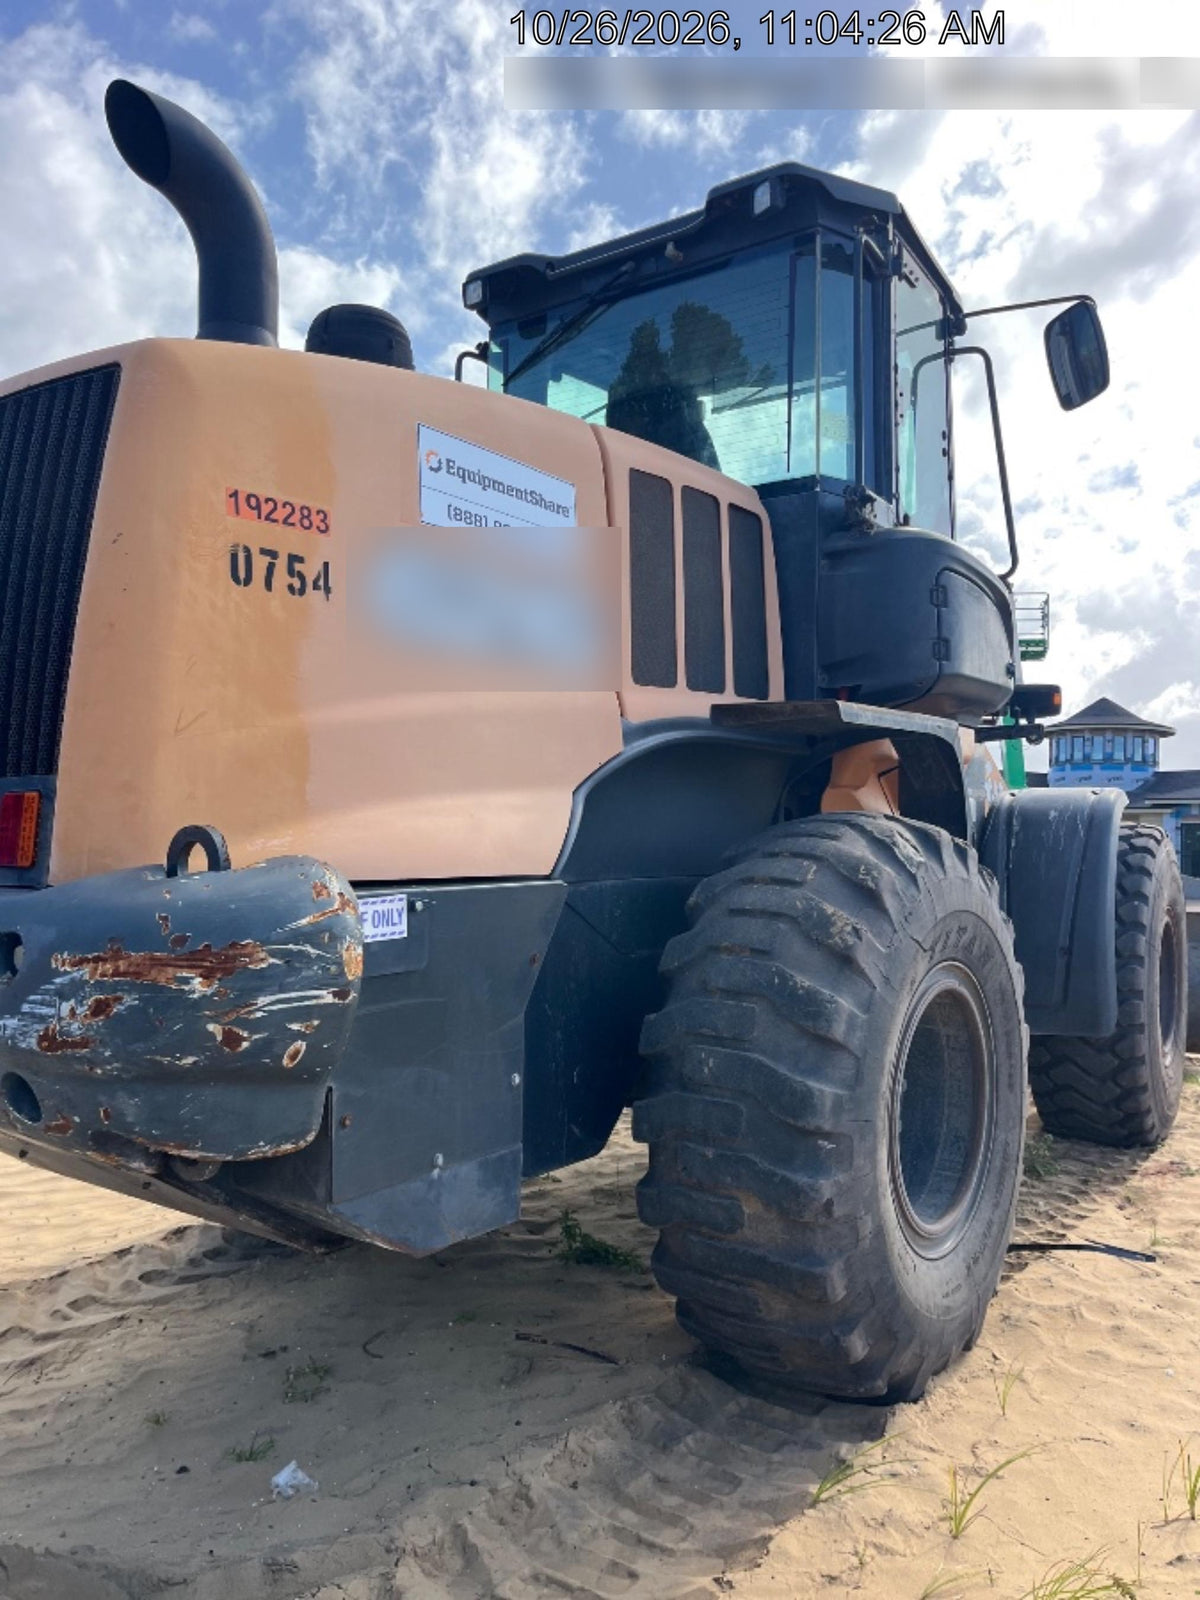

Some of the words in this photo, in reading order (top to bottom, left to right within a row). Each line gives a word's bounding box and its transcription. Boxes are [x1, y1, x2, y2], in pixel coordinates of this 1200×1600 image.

[228, 489, 330, 534] 192283
[445, 458, 571, 518] EquipmentShare
[229, 544, 332, 602] 0754
[372, 906, 404, 928] ONLY
